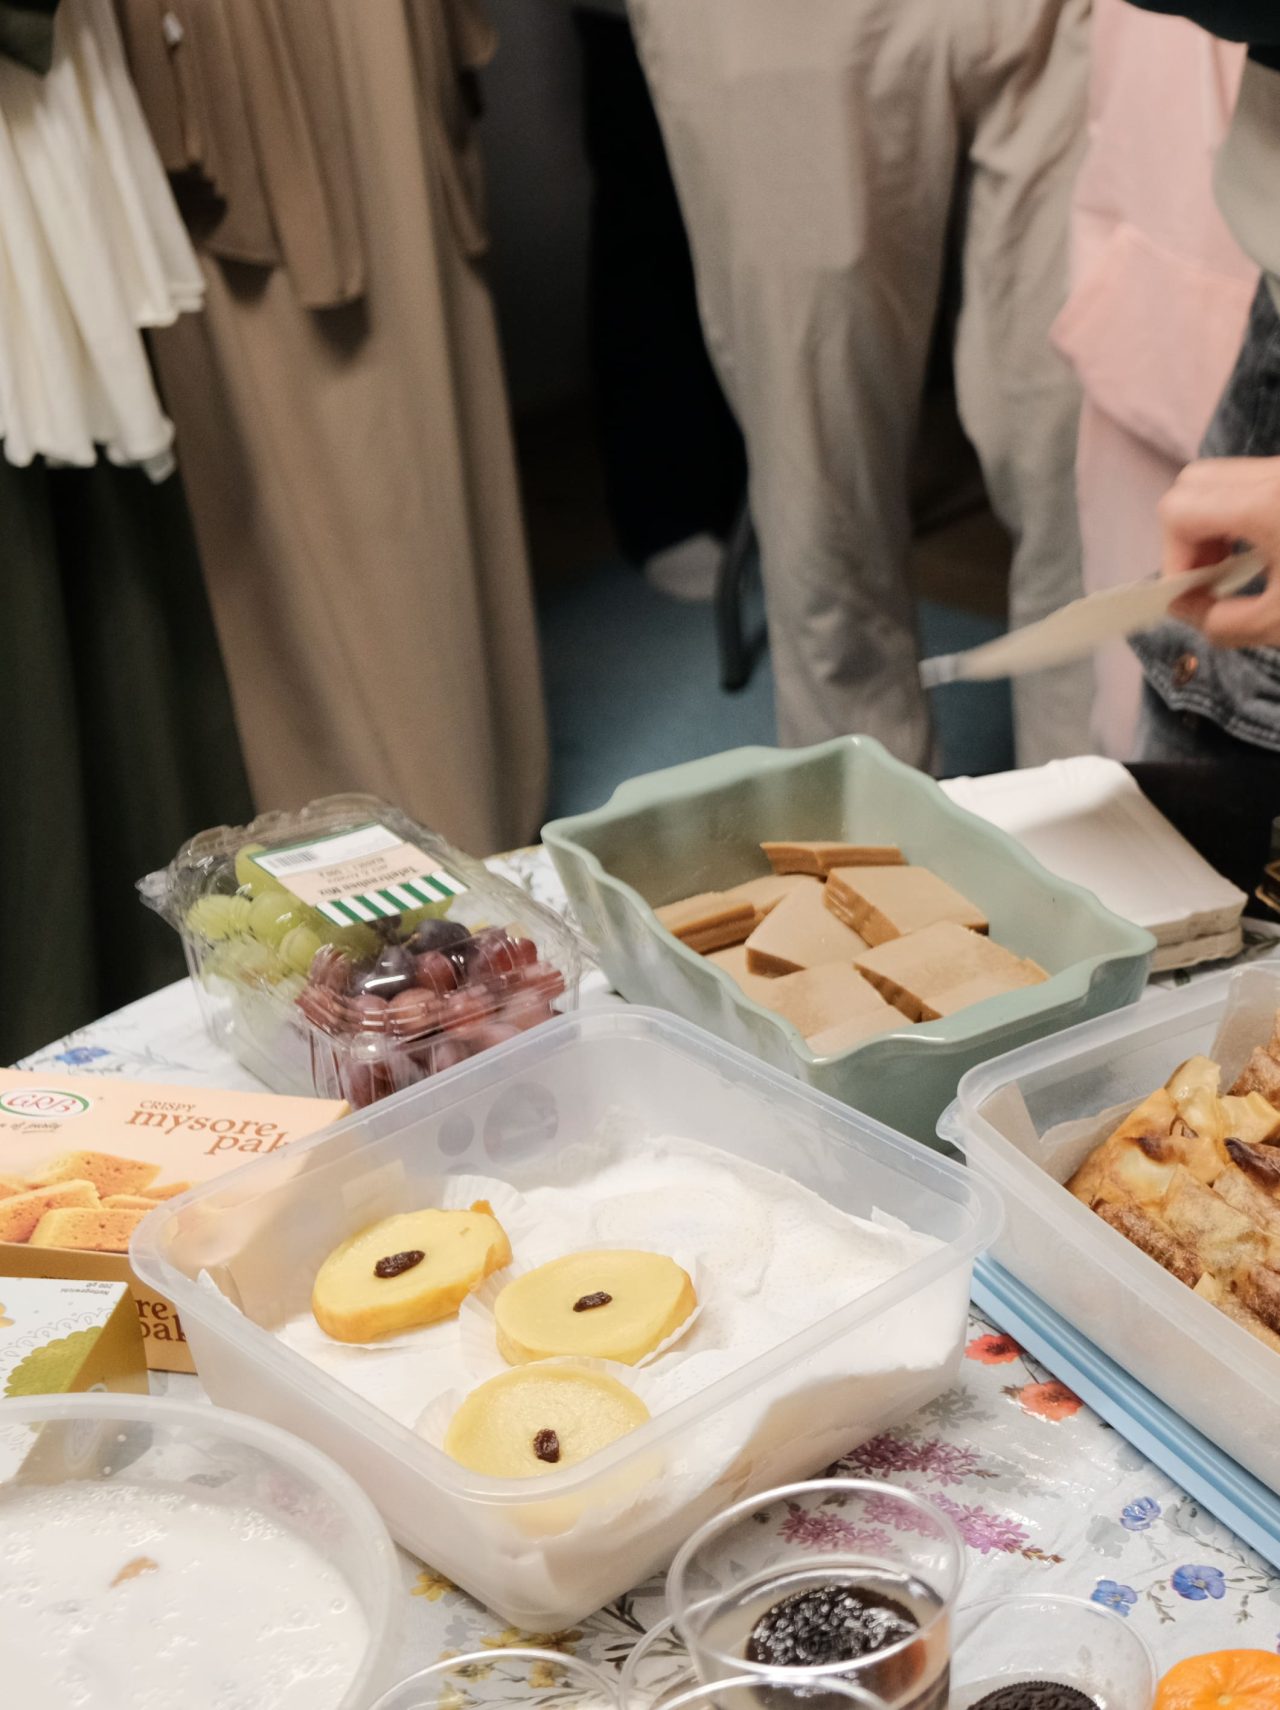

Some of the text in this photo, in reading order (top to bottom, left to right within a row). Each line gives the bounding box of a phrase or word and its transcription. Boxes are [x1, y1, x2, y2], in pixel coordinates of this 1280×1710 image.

[319, 885, 342, 897] Mix
[140, 1100, 196, 1112] CRISPY
[125, 1110, 278, 1137] mysore
